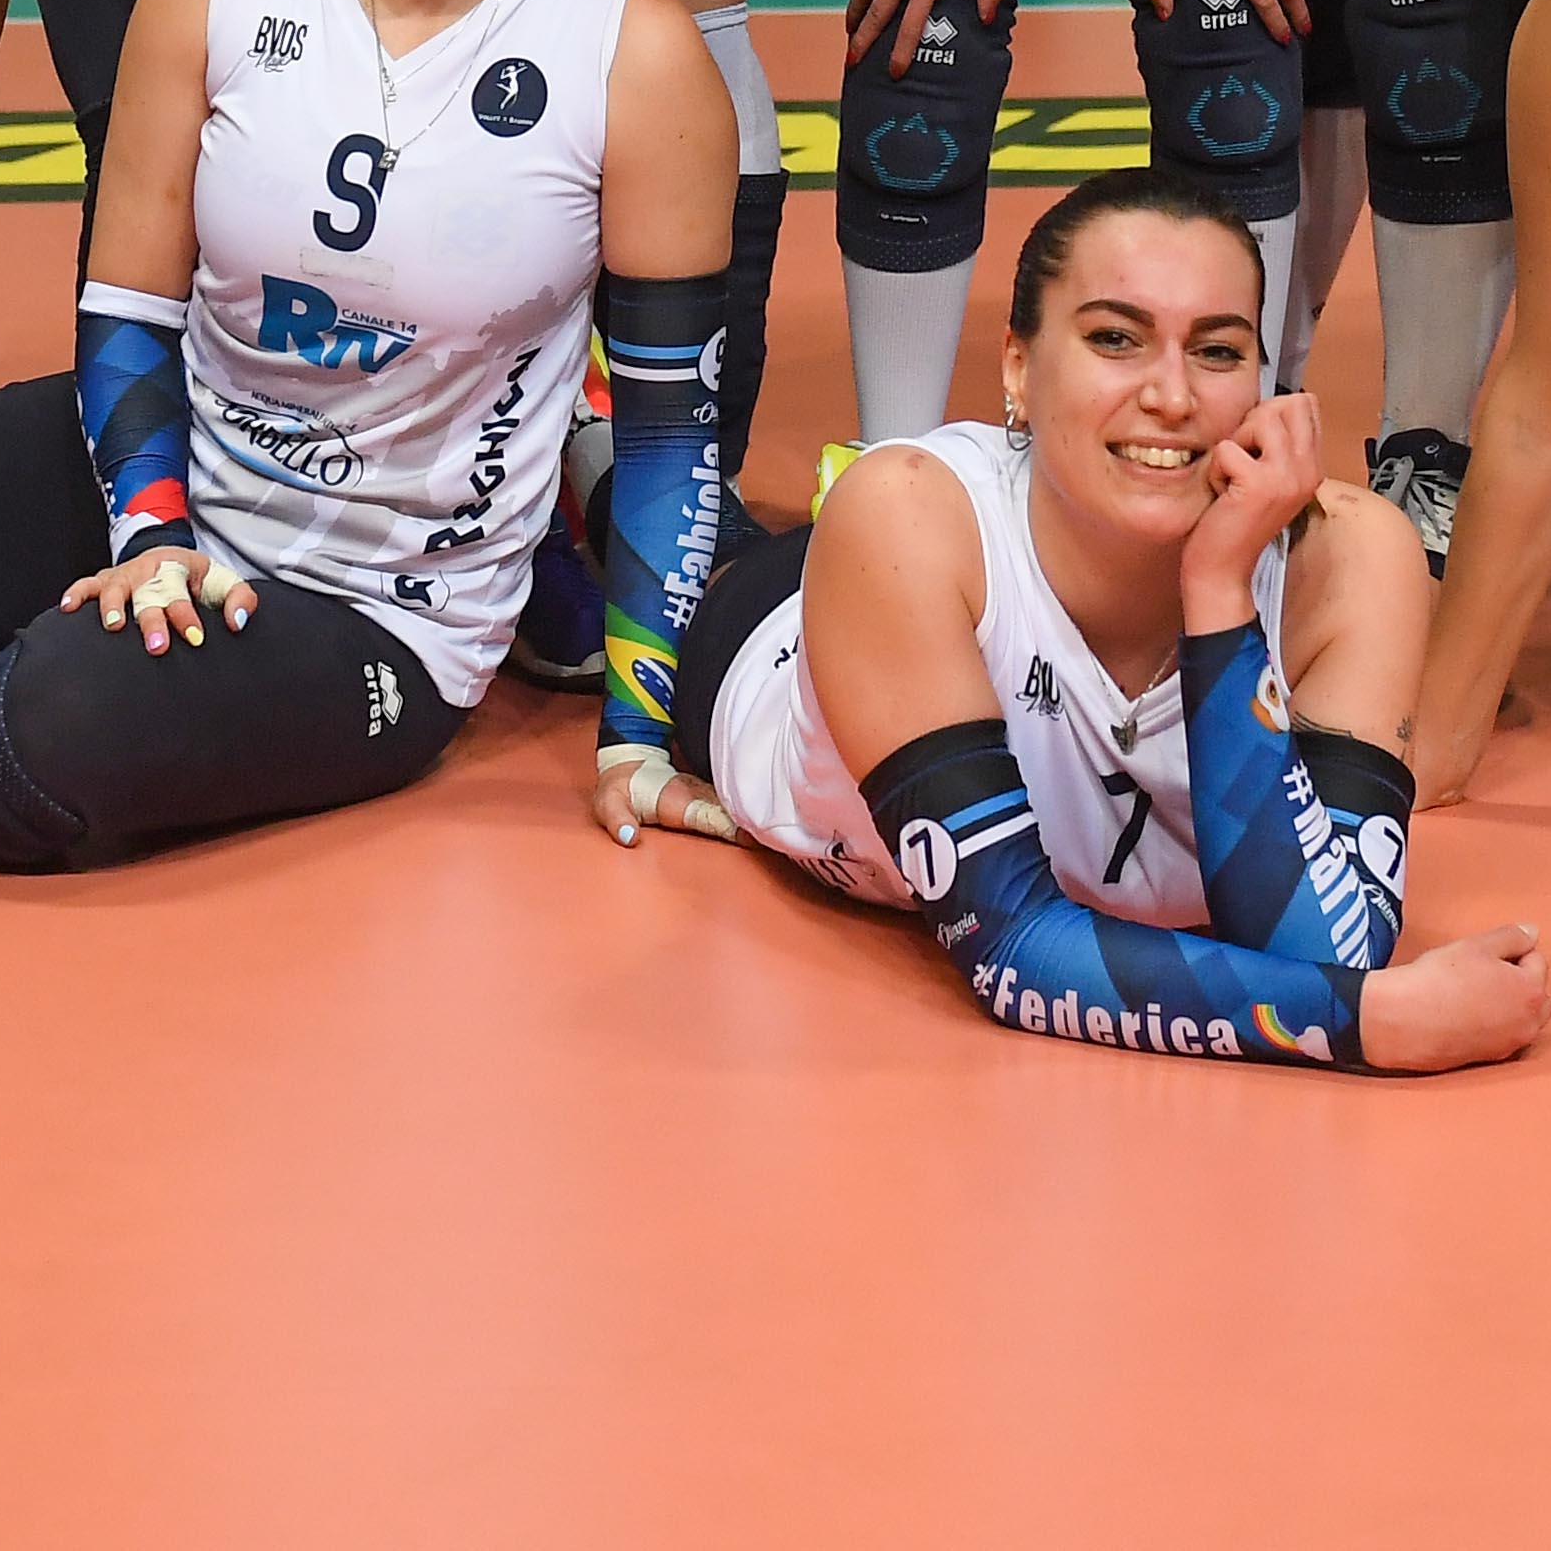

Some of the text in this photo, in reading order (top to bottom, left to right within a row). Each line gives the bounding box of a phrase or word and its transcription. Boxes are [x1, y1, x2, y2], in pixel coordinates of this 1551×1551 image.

[253, 15, 309, 62] BVOS
[1200, 9, 1248, 30] errea
[913, 47, 956, 66] rrea
[340, 308, 418, 335] CANALE 14
[1101, 771, 1151, 885] 7
[1381, 825, 1404, 882] 7
[906, 826, 936, 890] 7
[972, 961, 1244, 1058] #Federica
